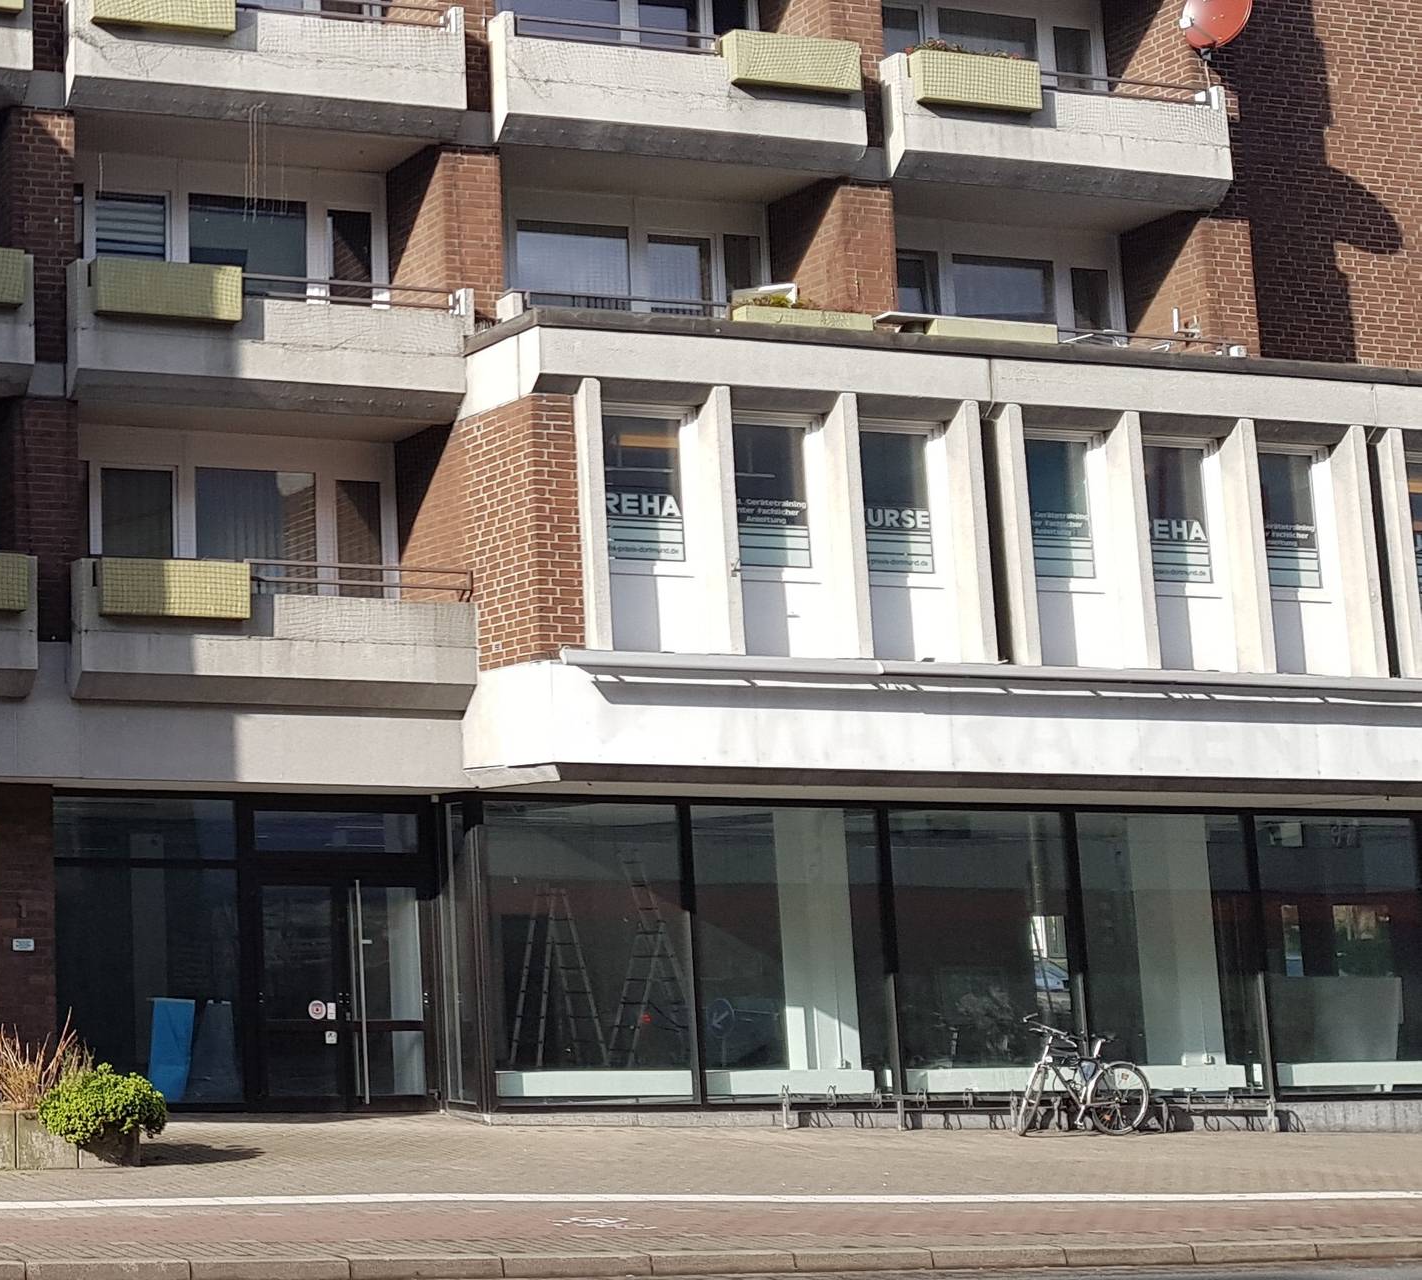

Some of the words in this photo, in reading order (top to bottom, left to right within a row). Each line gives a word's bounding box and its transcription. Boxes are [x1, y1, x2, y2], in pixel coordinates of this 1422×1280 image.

[606, 492, 682, 517] REHA
[866, 508, 930, 529] URSE
[1152, 519, 1208, 541] EHA
